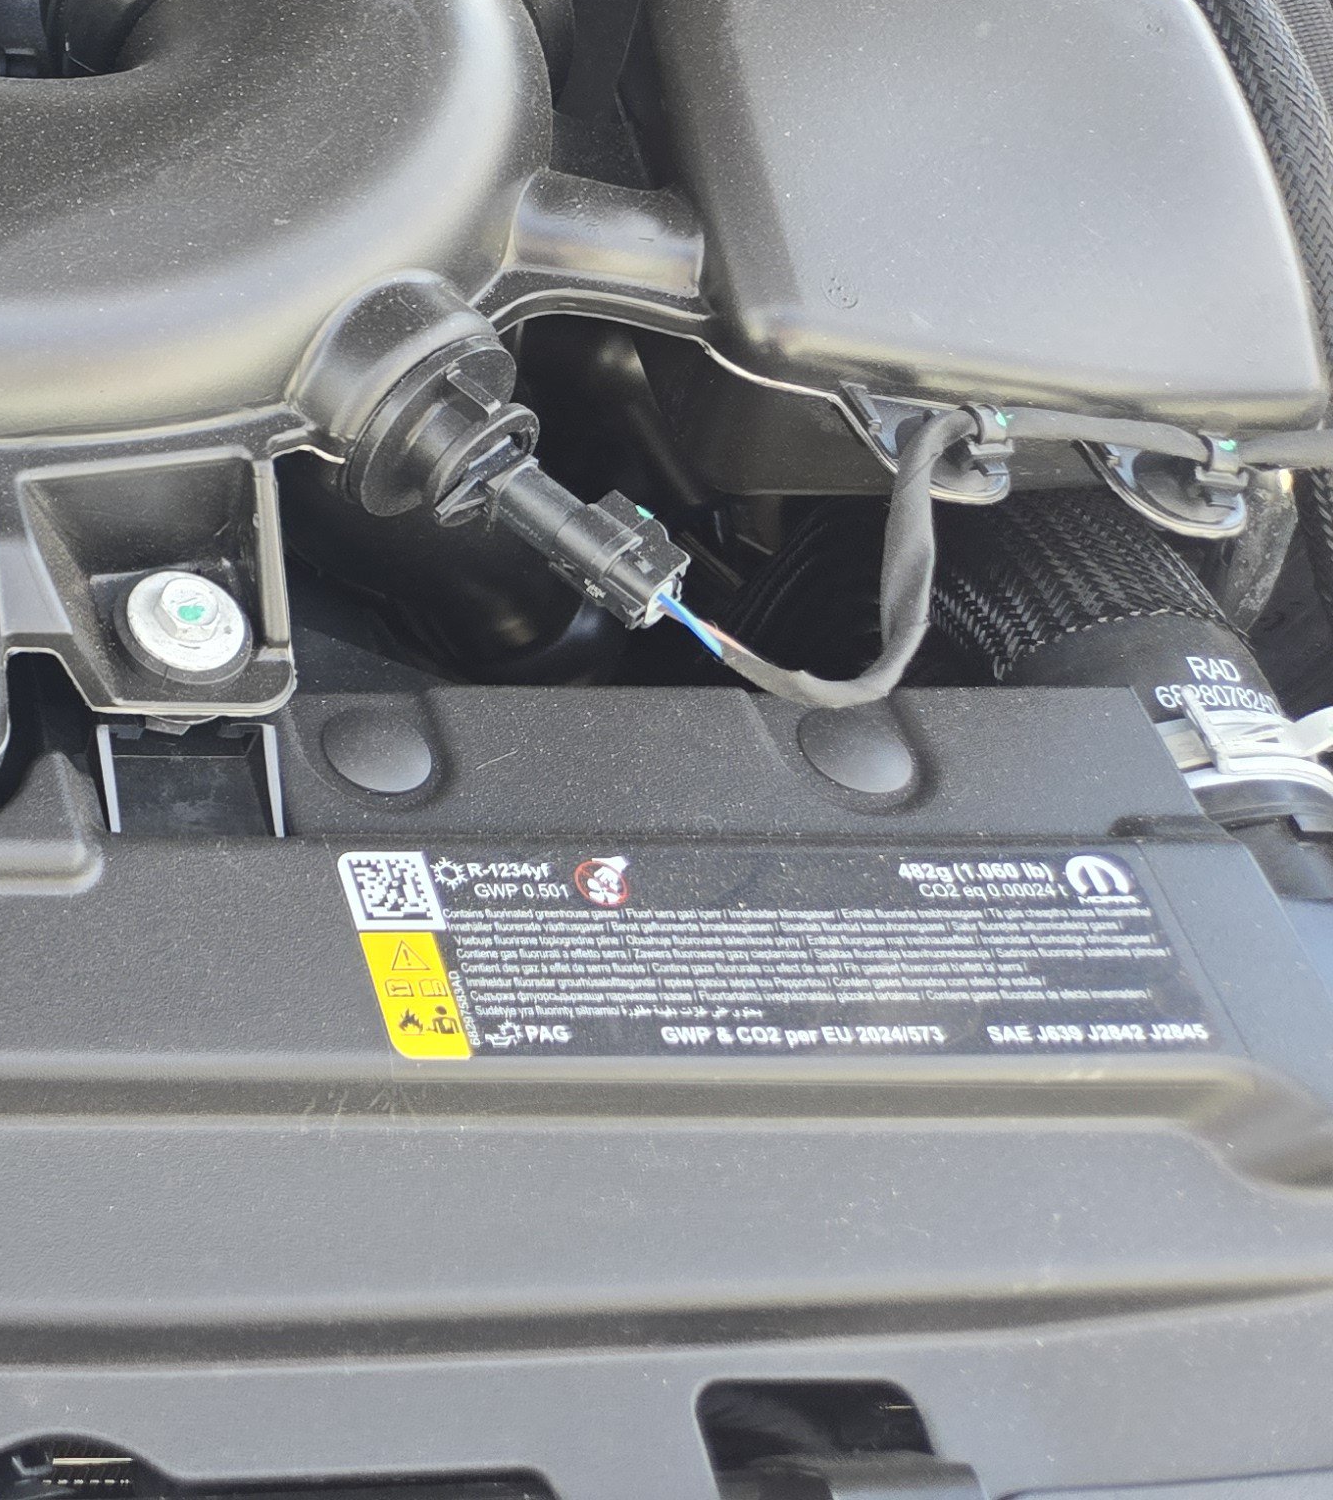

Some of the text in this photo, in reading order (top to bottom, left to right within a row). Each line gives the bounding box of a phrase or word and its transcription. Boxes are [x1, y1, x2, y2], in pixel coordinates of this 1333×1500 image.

[1185, 656, 1241, 682] RAD
[466, 861, 550, 880] R-1234yf
[898, 861, 1055, 883] 482g (1.060 lb)
[473, 883, 518, 899] GWP
[918, 883, 960, 898] CO2
[986, 883, 1054, 899] 0.00024
[442, 908, 484, 919] Contains
[484, 907, 533, 919] fluorinated
[535, 908, 589, 921] greenhouse
[591, 909, 620, 921] gases
[456, 948, 499, 959] Contiene
[460, 961, 500, 973] Contient
[524, 1025, 572, 1043] PAG
[660, 1025, 947, 1048] GWP & CO2 per EU 2024/573
[986, 1022, 1209, 1042] SAE J639 J2842 J2845
